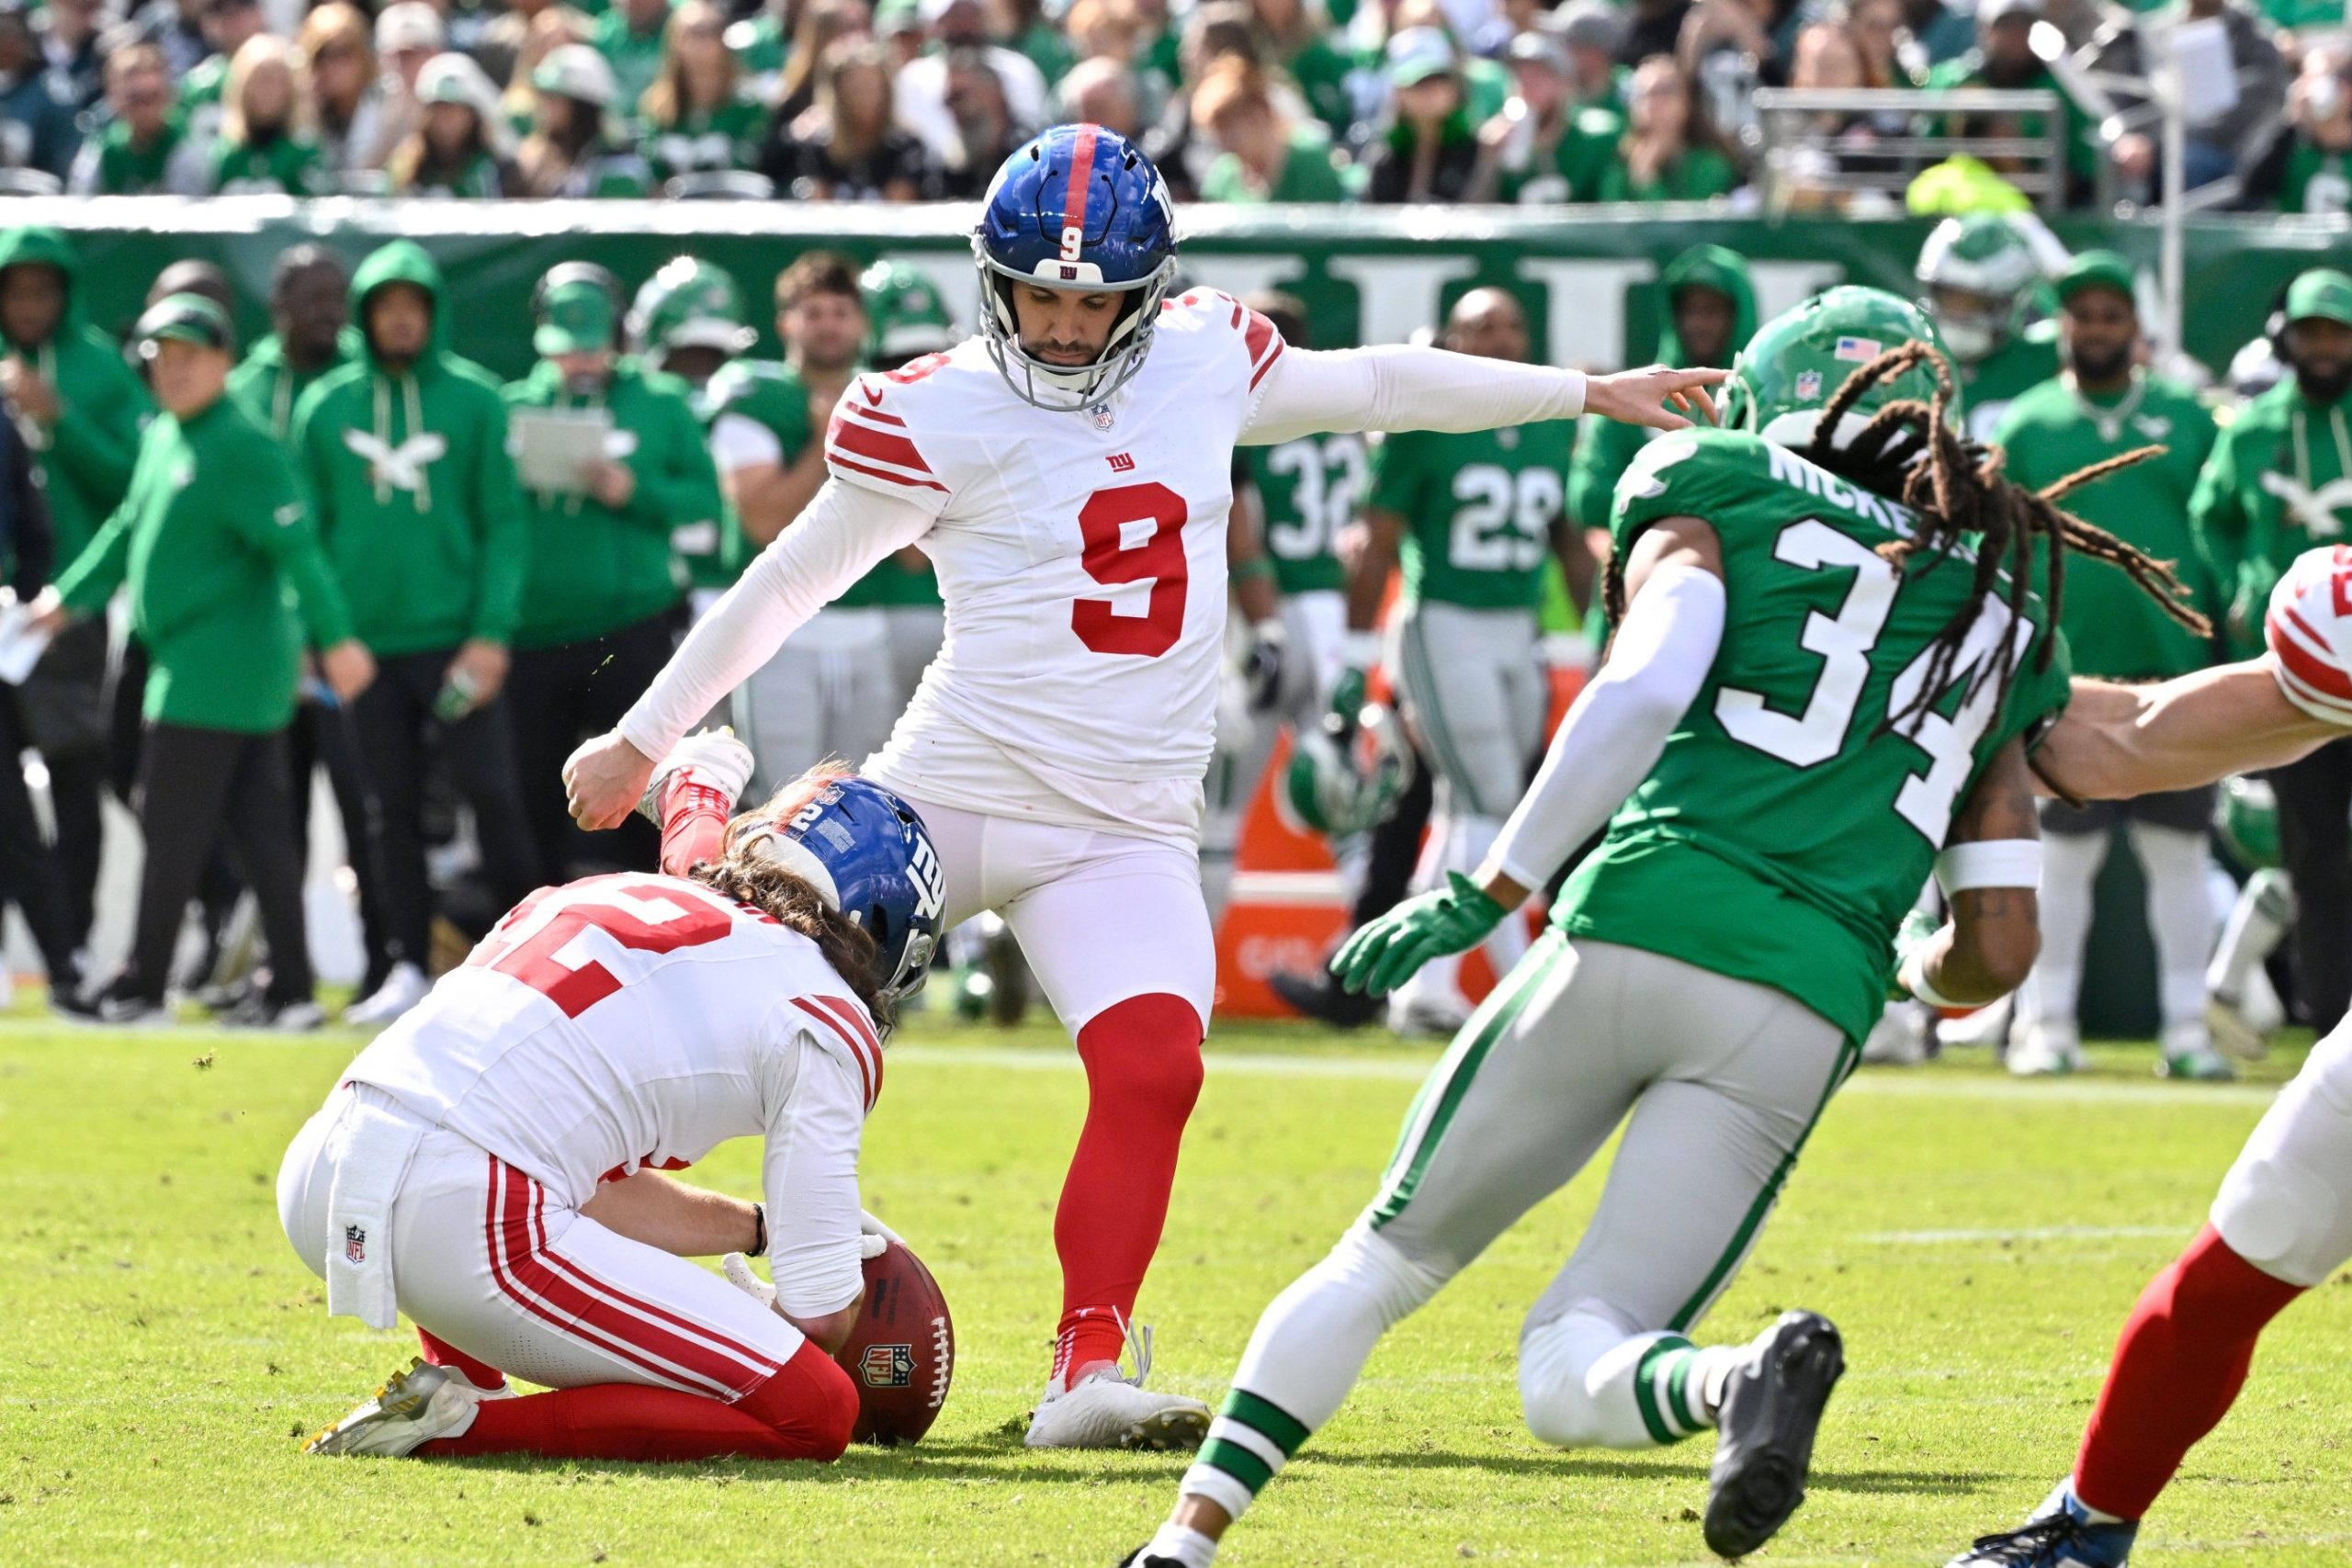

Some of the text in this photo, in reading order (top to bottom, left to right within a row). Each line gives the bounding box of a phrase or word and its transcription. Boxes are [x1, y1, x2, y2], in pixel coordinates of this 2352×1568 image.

[1060, 227, 1082, 261] 9
[1105, 452, 1135, 473] ny
[1448, 463, 1562, 571] 29
[1071, 481, 1188, 658] 9
[1713, 517, 2035, 851] 34
[789, 803, 823, 831] 2
[347, 1241, 366, 1261] NFL
[866, 1349, 891, 1384] NFL
